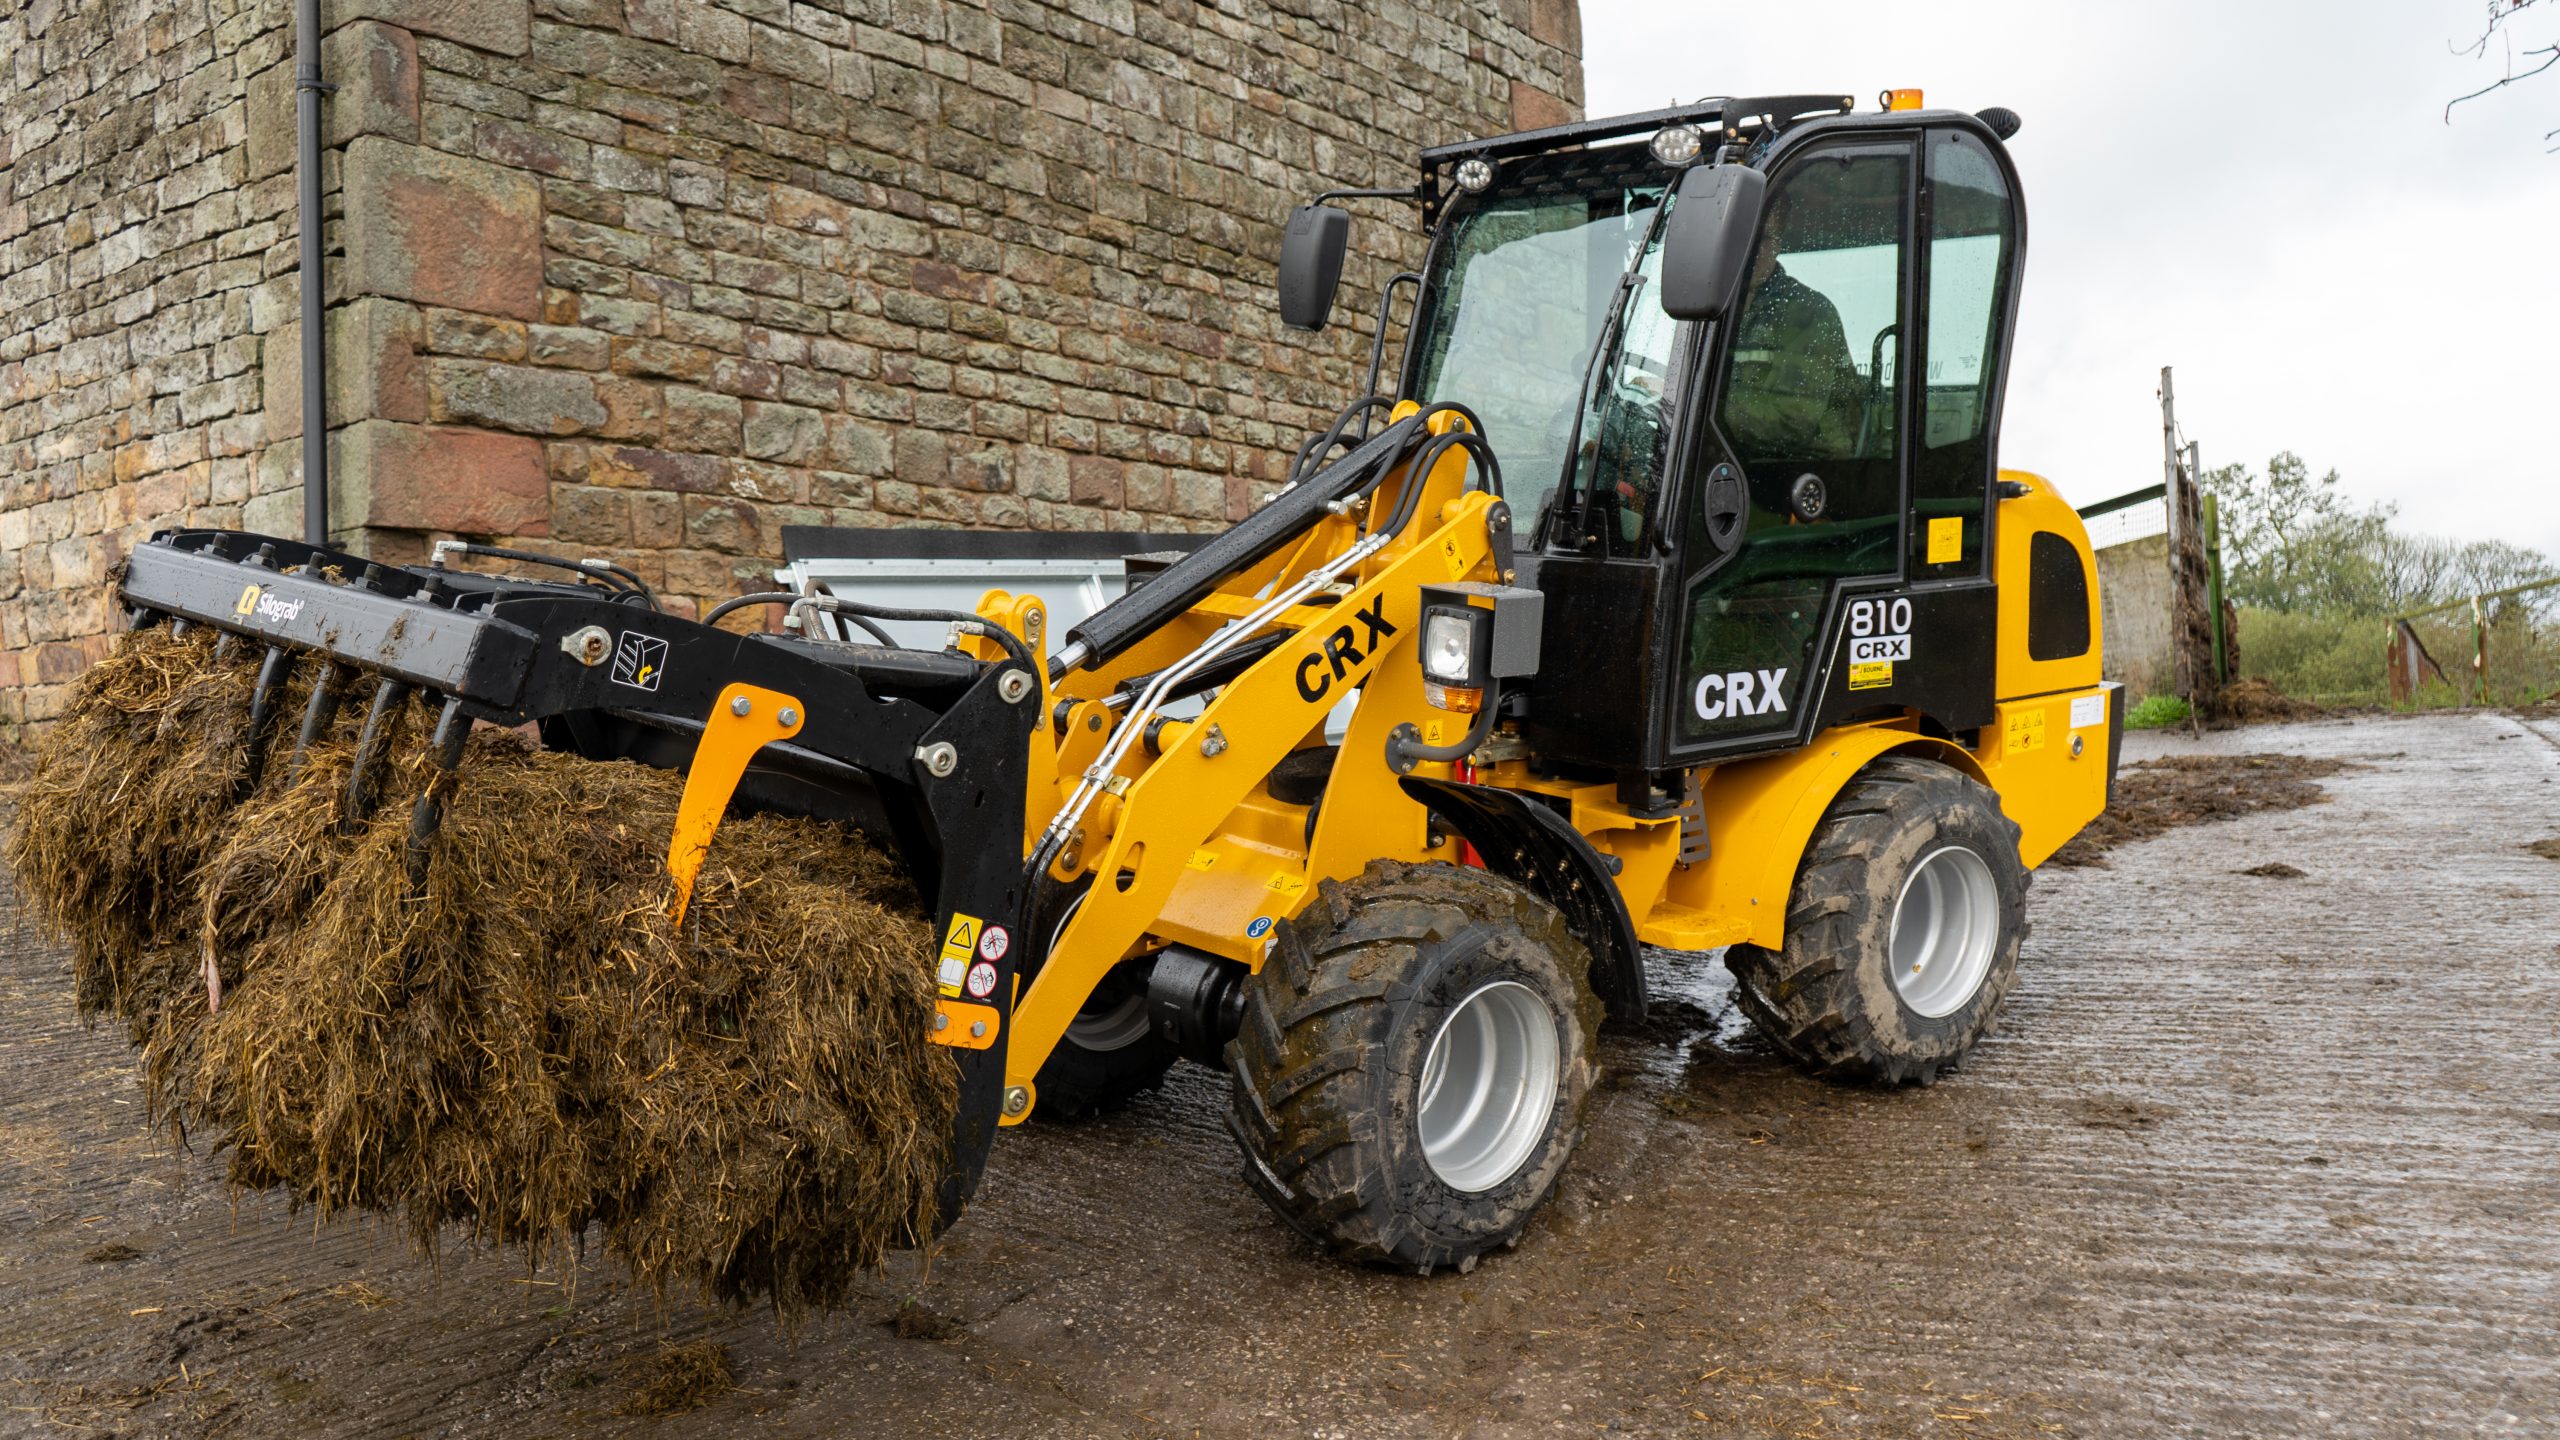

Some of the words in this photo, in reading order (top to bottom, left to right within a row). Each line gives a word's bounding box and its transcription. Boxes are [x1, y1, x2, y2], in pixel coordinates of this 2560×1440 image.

[1851, 598, 1912, 637] 810
[1296, 592, 1398, 703] CRX
[1857, 640, 1905, 659] CRX
[1695, 668, 1788, 720] CRX
